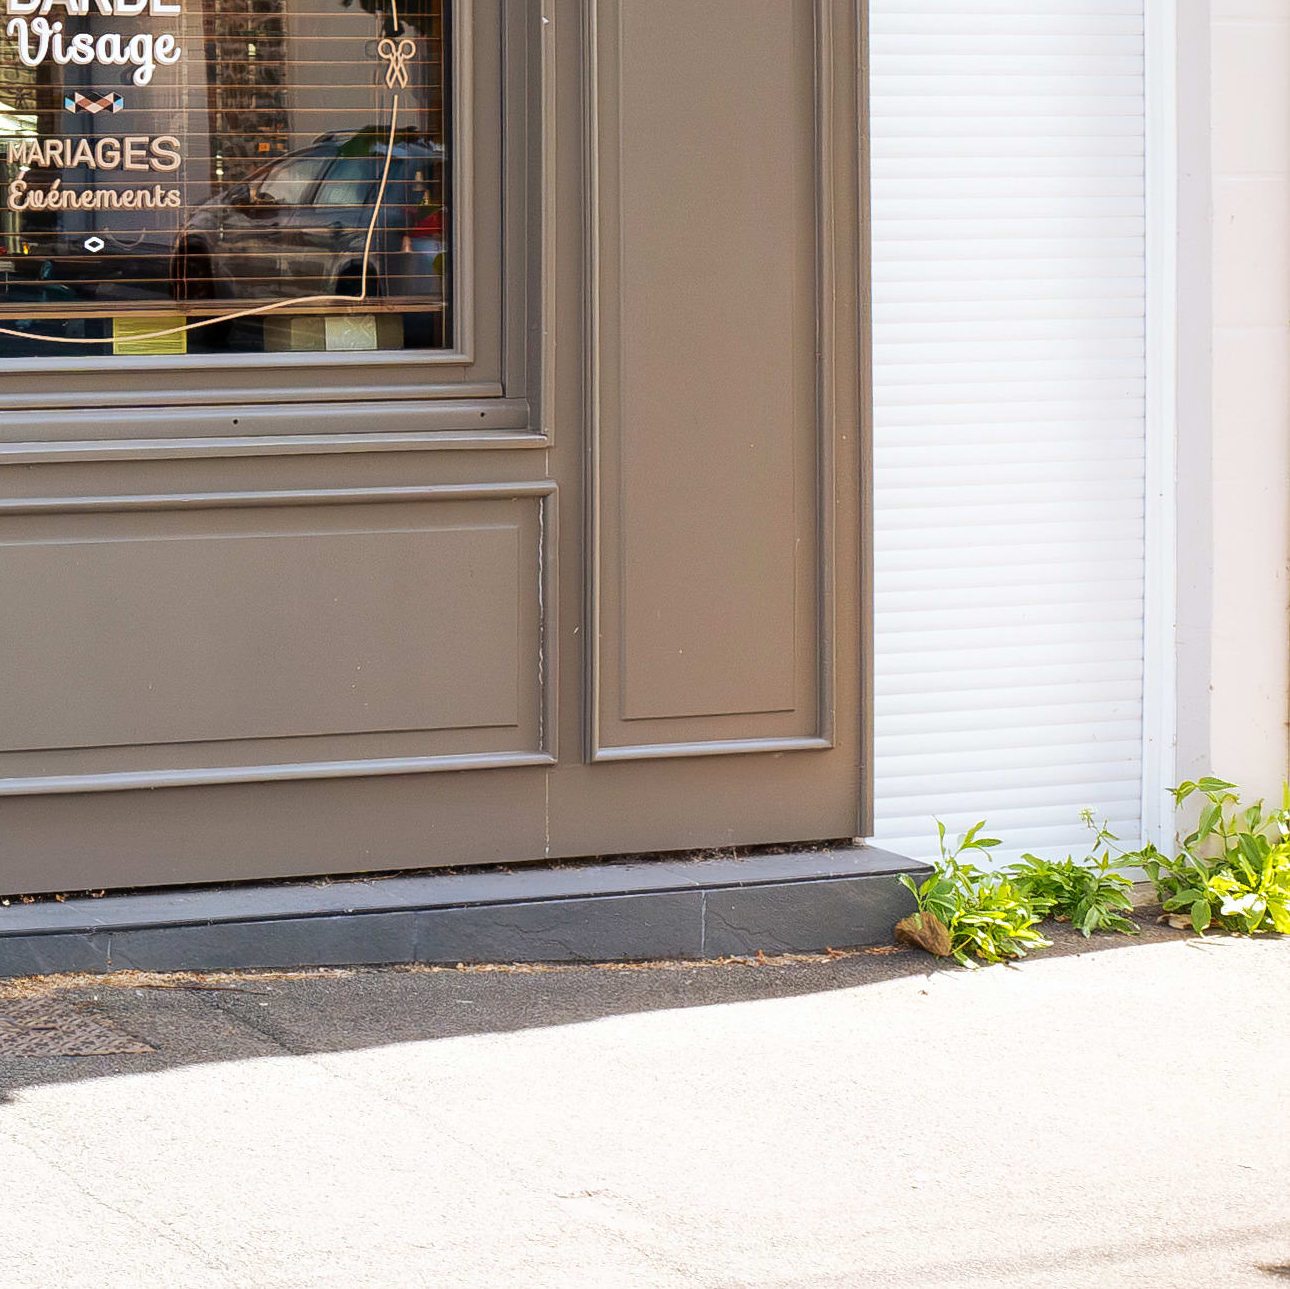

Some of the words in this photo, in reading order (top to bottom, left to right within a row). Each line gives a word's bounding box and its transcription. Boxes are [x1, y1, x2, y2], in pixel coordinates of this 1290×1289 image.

[6, 16, 182, 87] Visage
[6, 135, 182, 173] MARIAGES
[7, 169, 181, 211] Événements
